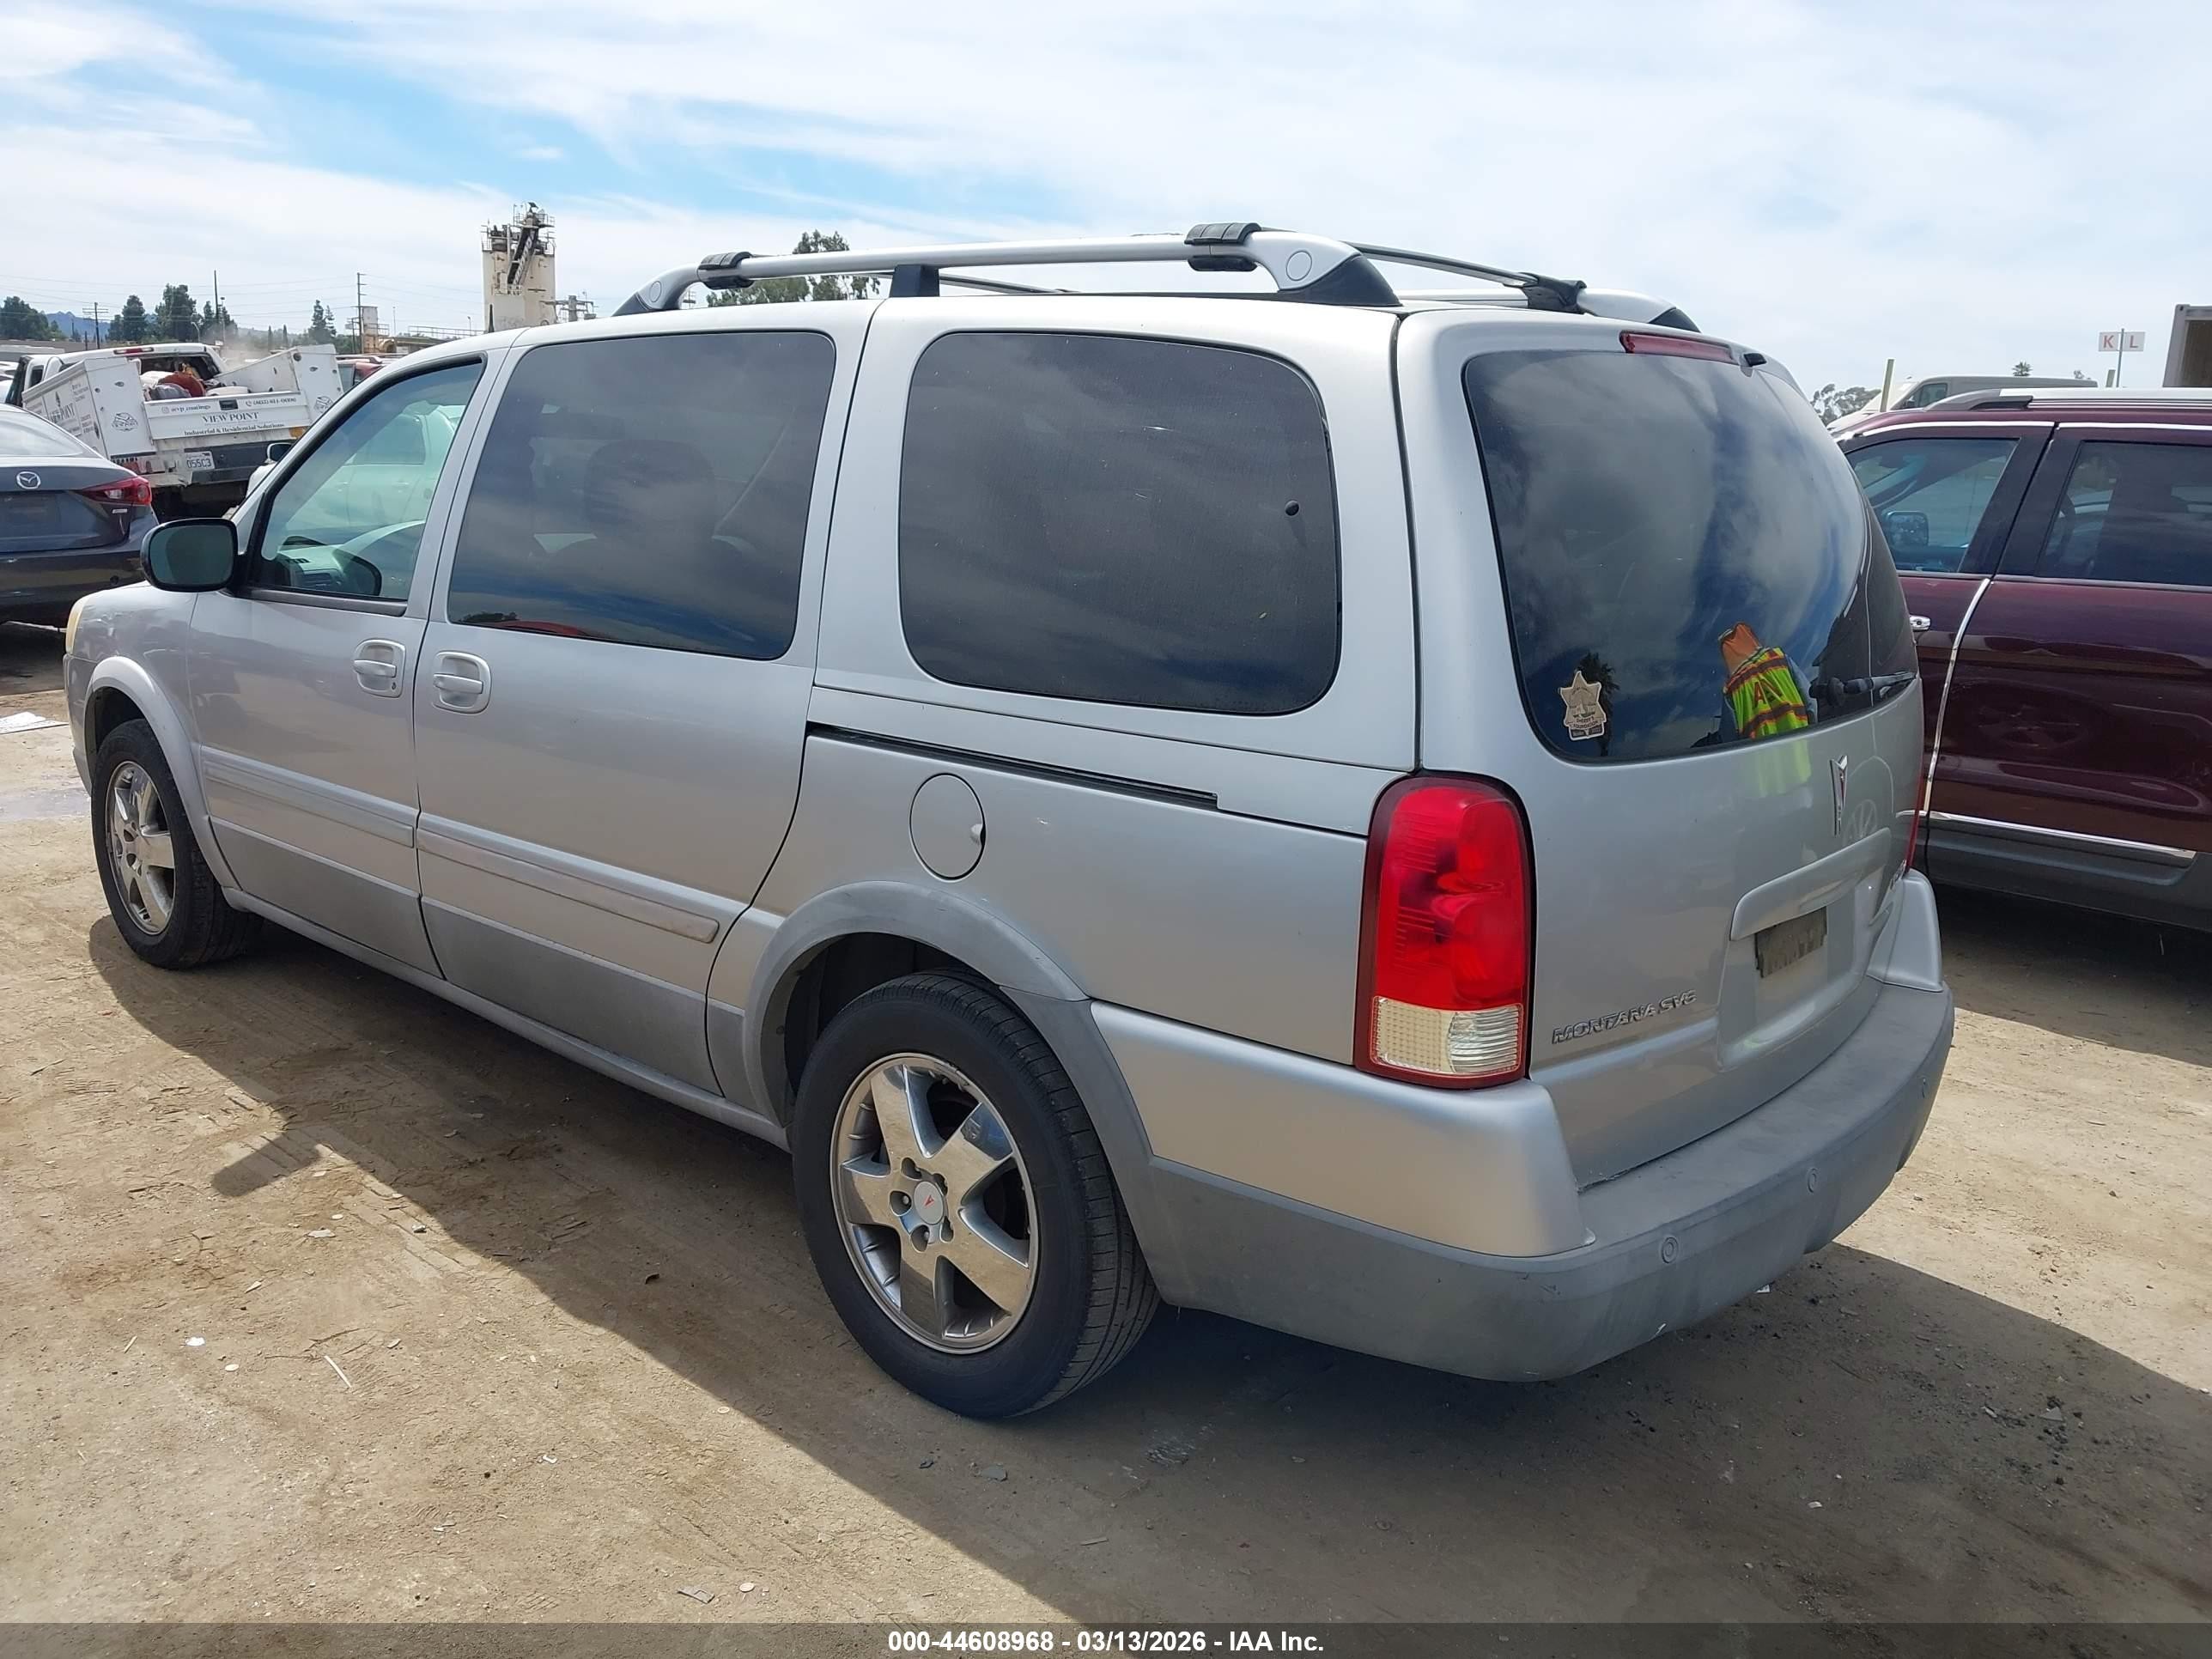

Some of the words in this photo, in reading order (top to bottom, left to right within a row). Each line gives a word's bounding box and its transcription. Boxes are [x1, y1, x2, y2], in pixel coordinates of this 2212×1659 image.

[2103, 335, 2114, 349] K
[2130, 335, 2139, 349] L
[202, 413, 227, 423] VIEW
[230, 412, 259, 421] POINT
[222, 424, 257, 433] Residential
[1551, 1003, 1657, 1045] MONTANA
